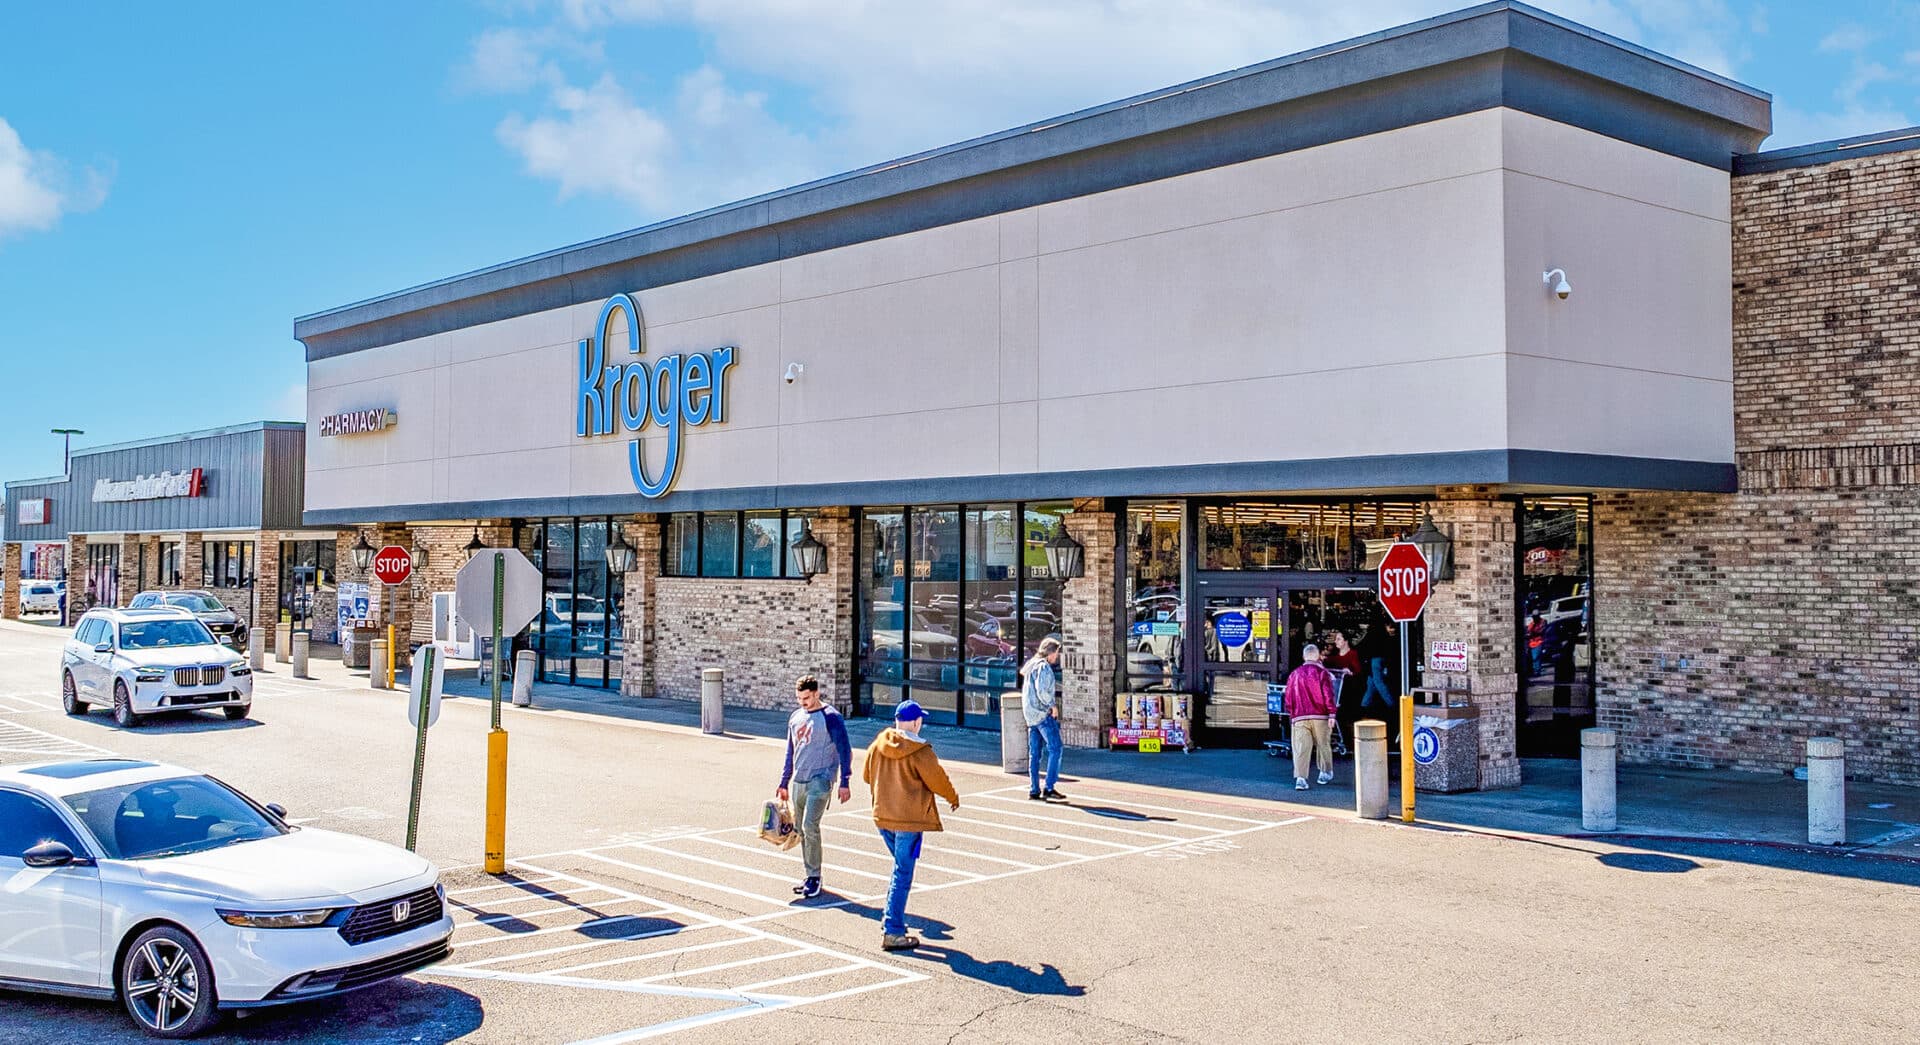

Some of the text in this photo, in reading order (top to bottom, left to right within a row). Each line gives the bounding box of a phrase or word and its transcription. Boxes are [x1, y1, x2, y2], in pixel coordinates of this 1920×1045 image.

[576, 293, 738, 499] Kroger
[319, 408, 385, 437] PHARMACY
[377, 558, 409, 573] STOP
[1383, 567, 1426, 598] STOP
[1433, 642, 1466, 653] FIRE LANE
[1431, 660, 1466, 671] NO PARKING
